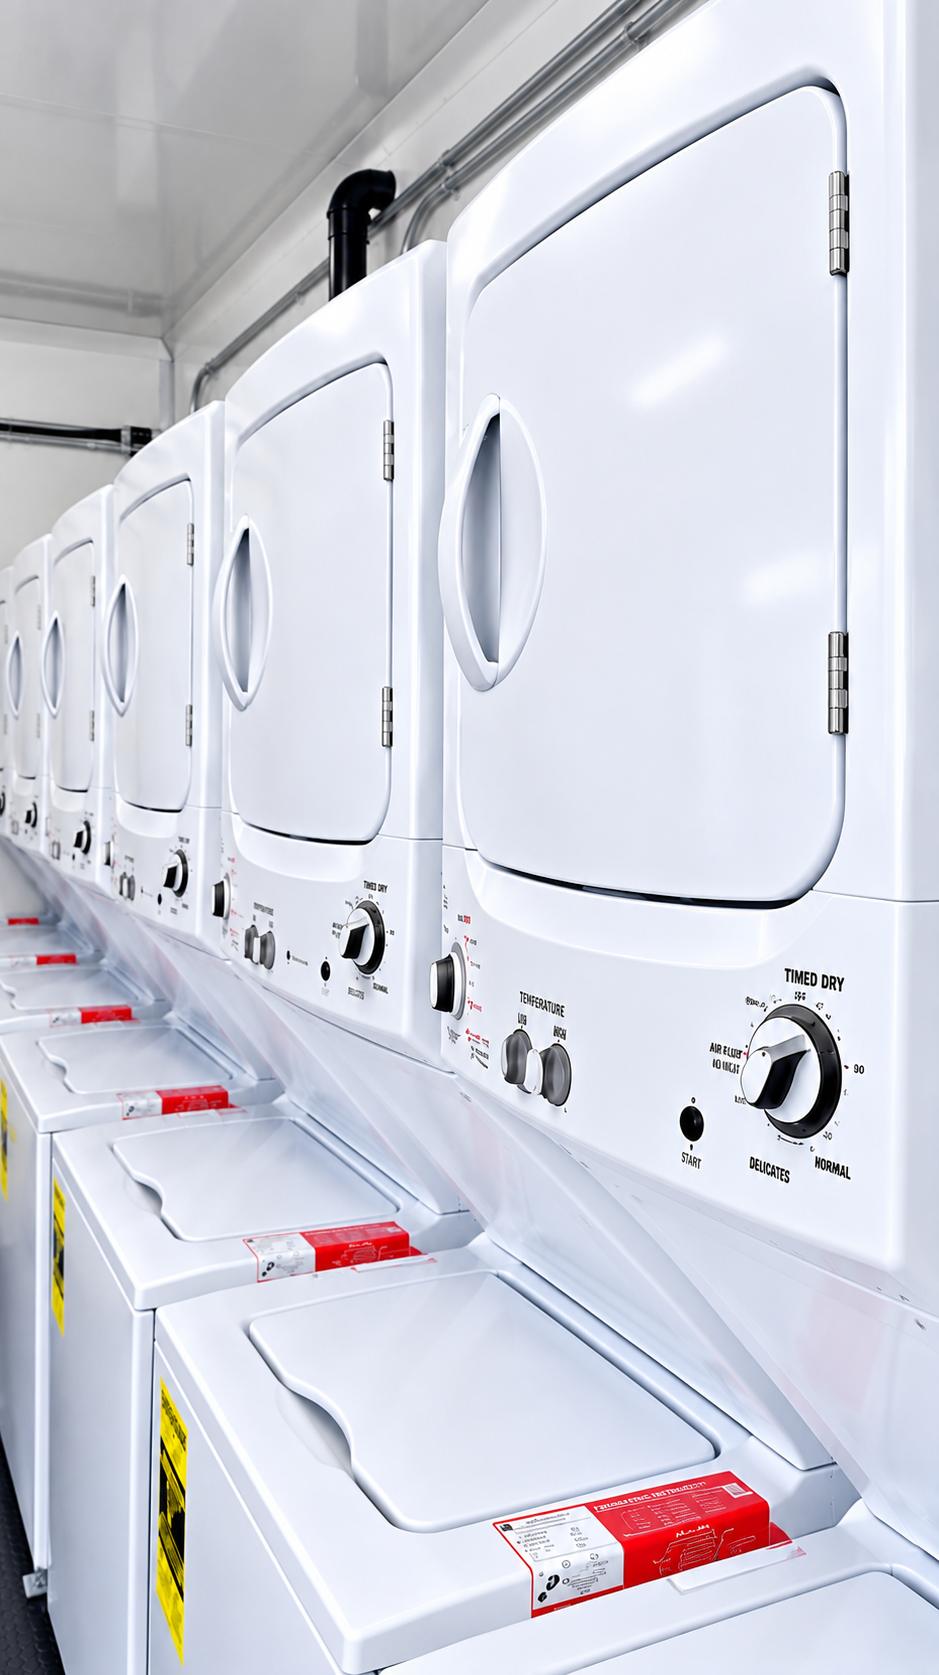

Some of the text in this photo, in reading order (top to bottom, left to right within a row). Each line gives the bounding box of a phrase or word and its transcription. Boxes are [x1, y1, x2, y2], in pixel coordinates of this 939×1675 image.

[784, 968, 845, 992] TIMED DRY
[853, 1064, 865, 1074] 90
[681, 1151, 702, 1170] START
[749, 1156, 790, 1183] DELICATES
